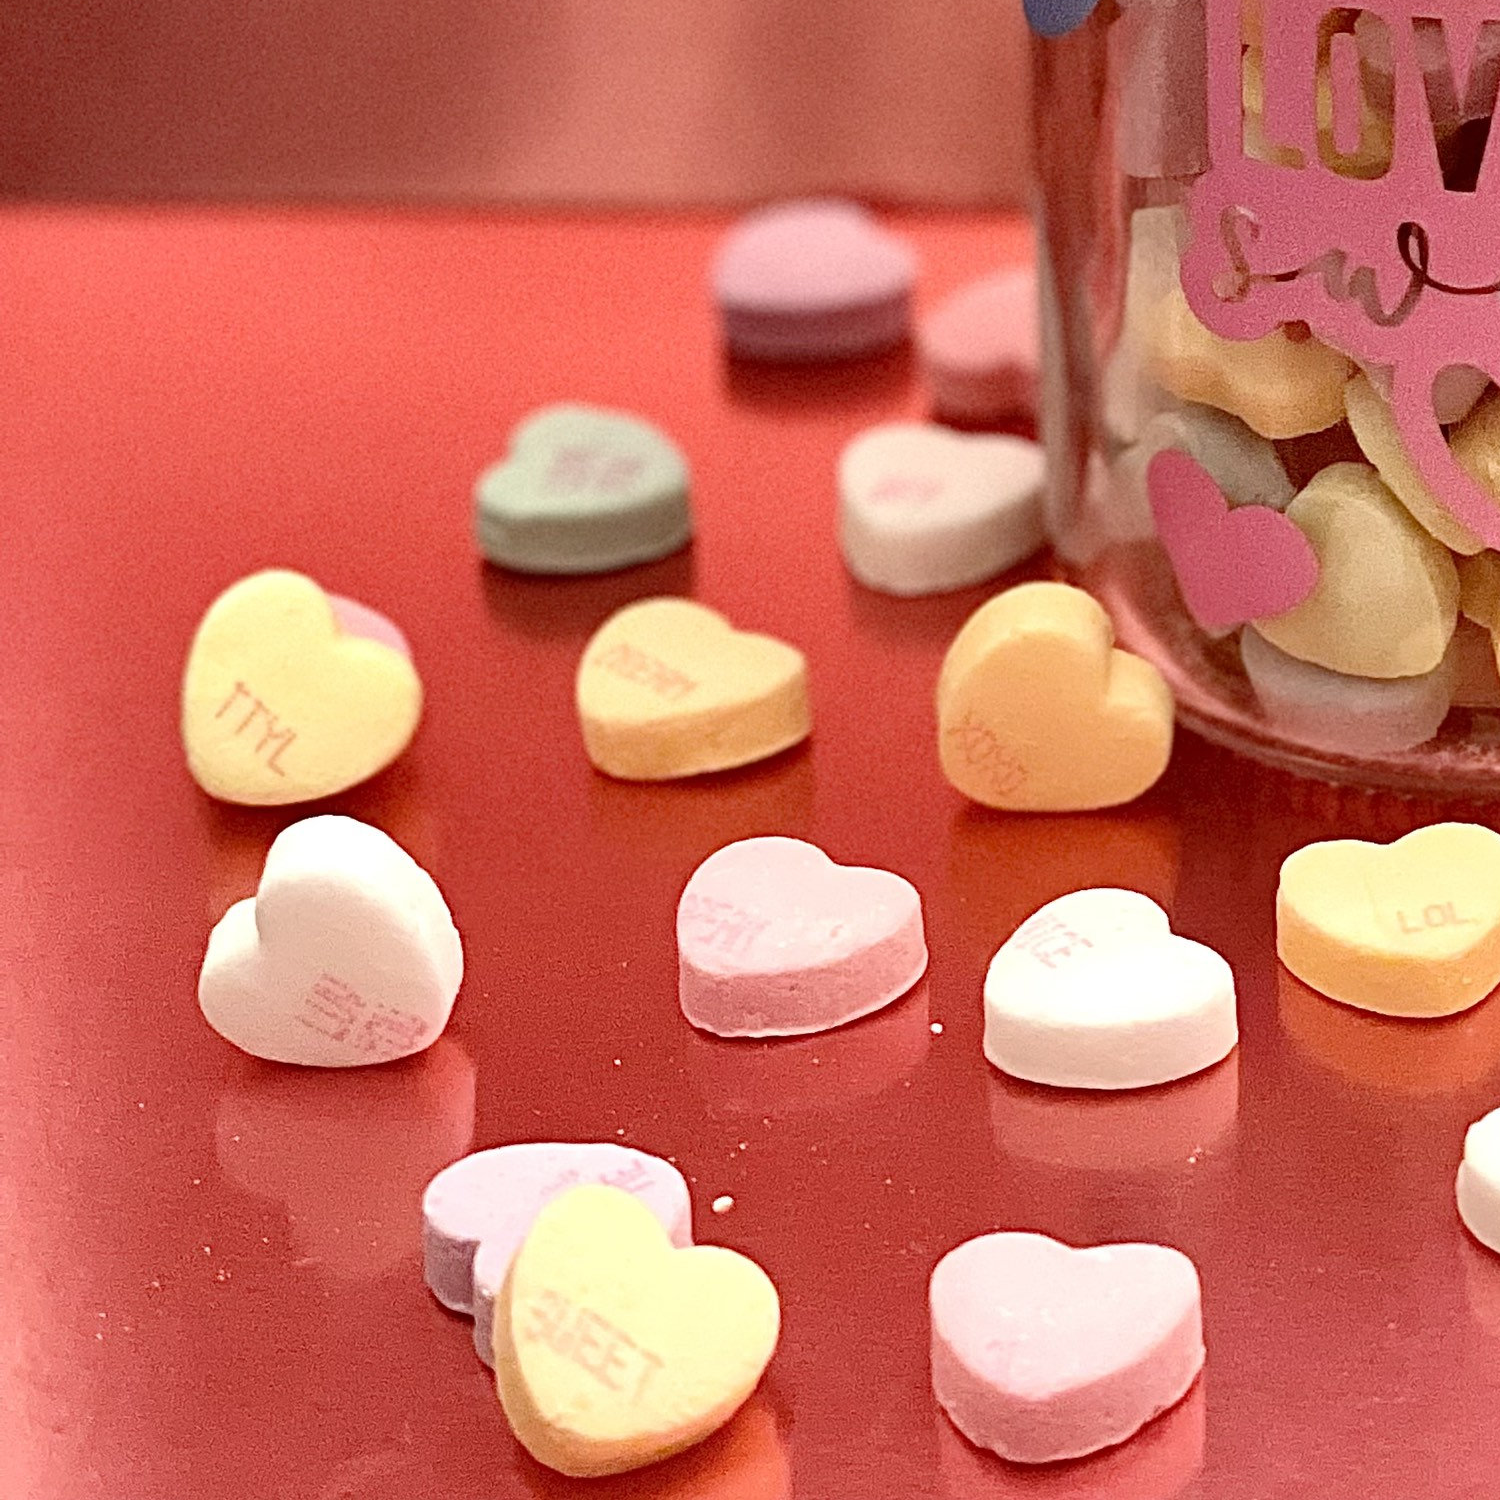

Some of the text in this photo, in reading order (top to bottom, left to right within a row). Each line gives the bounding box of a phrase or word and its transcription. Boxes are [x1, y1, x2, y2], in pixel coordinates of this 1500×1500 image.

[214, 682, 297, 777] TTYL
[1396, 901, 1470, 934] LOL
[524, 1288, 666, 1408] SWEET
